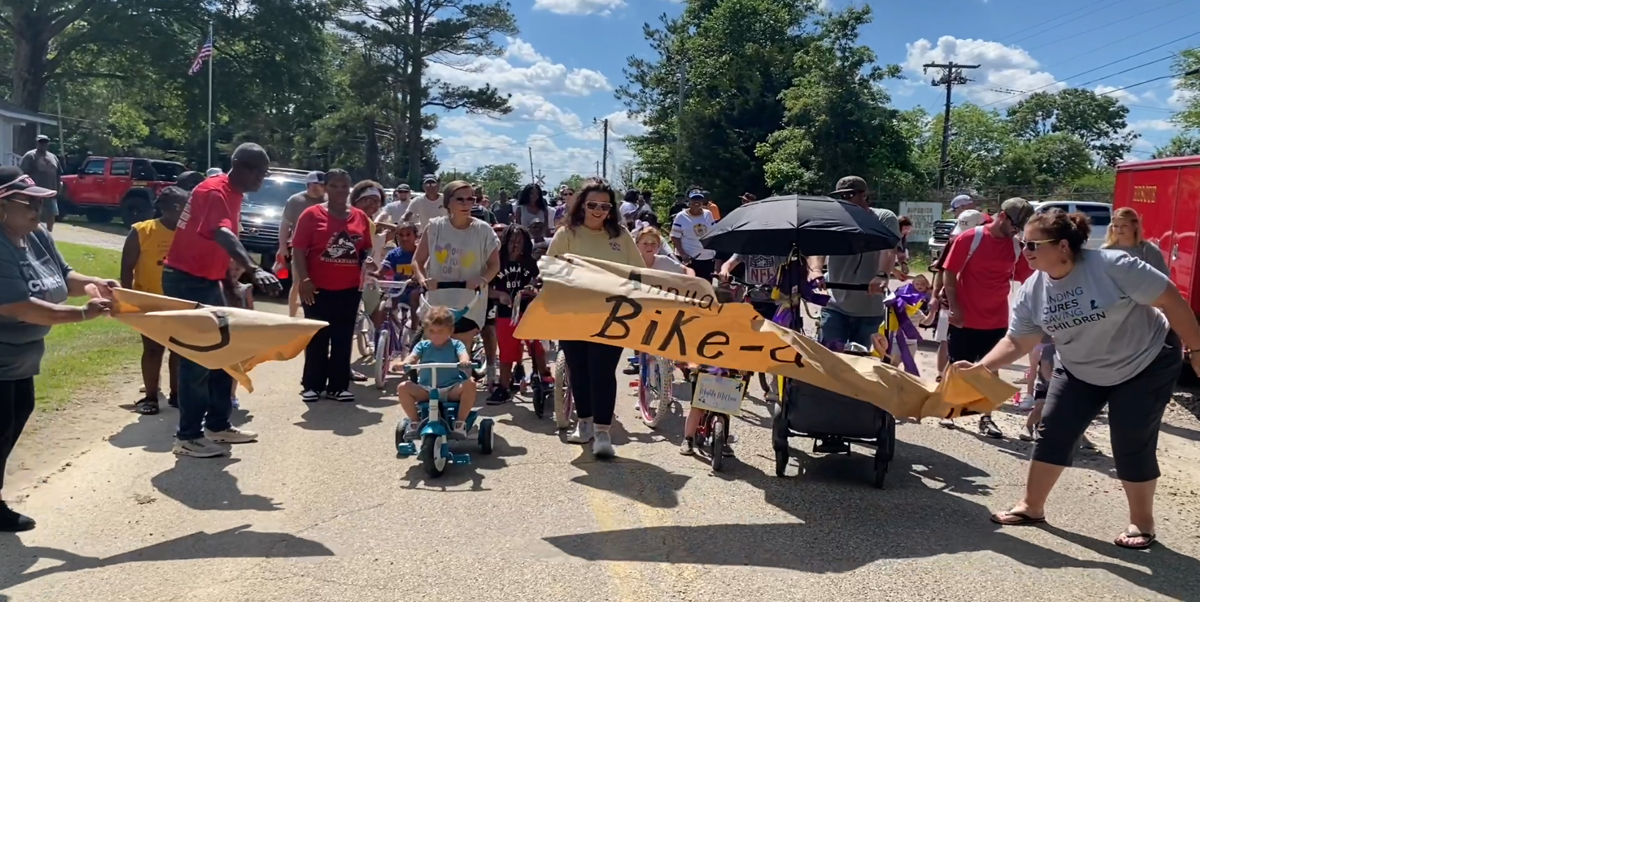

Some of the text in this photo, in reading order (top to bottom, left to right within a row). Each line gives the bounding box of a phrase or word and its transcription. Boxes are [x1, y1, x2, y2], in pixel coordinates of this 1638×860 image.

[497, 265, 530, 279] MAMA'S
[506, 281, 521, 289] BOY
[1043, 298, 1079, 315] CURES
[1043, 307, 1083, 325] SAVING
[1046, 311, 1106, 332] CHILDREN
